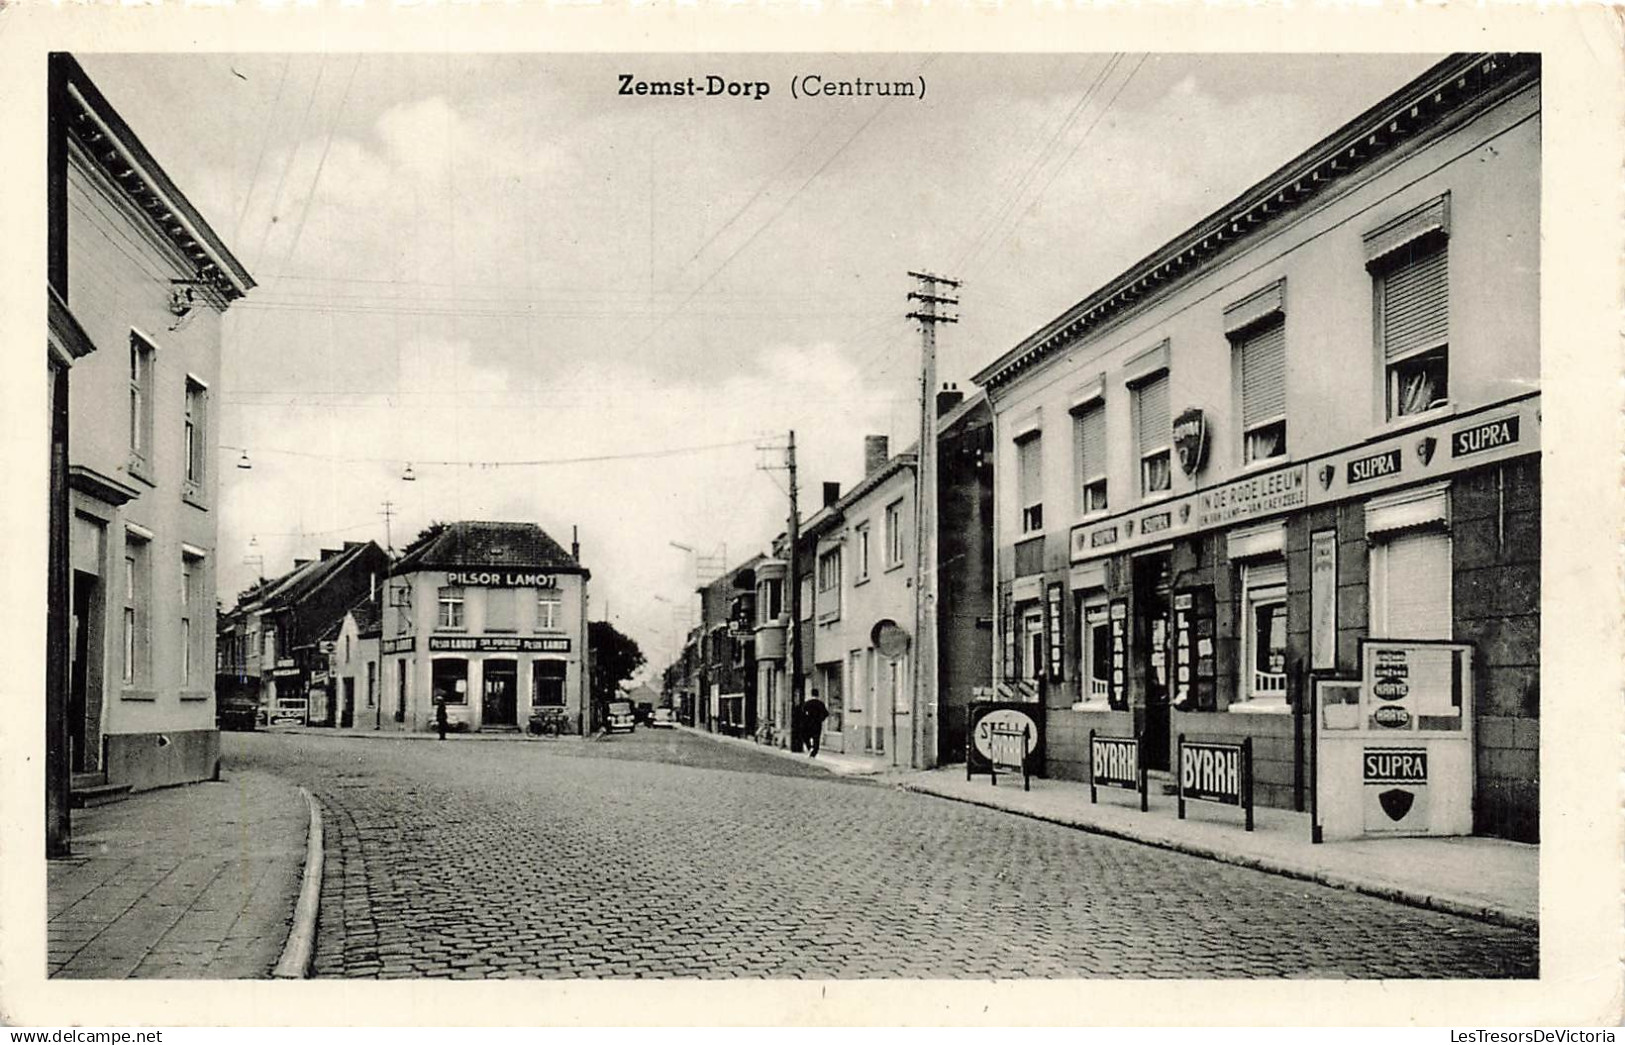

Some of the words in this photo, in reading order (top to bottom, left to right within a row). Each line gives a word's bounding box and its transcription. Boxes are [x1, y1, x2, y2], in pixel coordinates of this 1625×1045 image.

[1459, 422, 1511, 454] SUPRA
[1353, 454, 1395, 481] SUPRA
[1214, 489, 1227, 509] DE
[1230, 480, 1258, 505] RODE
[1261, 470, 1303, 498] LEEUW
[448, 573, 500, 585] PILSOR
[506, 574, 556, 586] LAMOT
[1093, 741, 1136, 782] BYRRH
[1183, 747, 1238, 795] BYRRH
[1366, 755, 1424, 777] SUPRA
